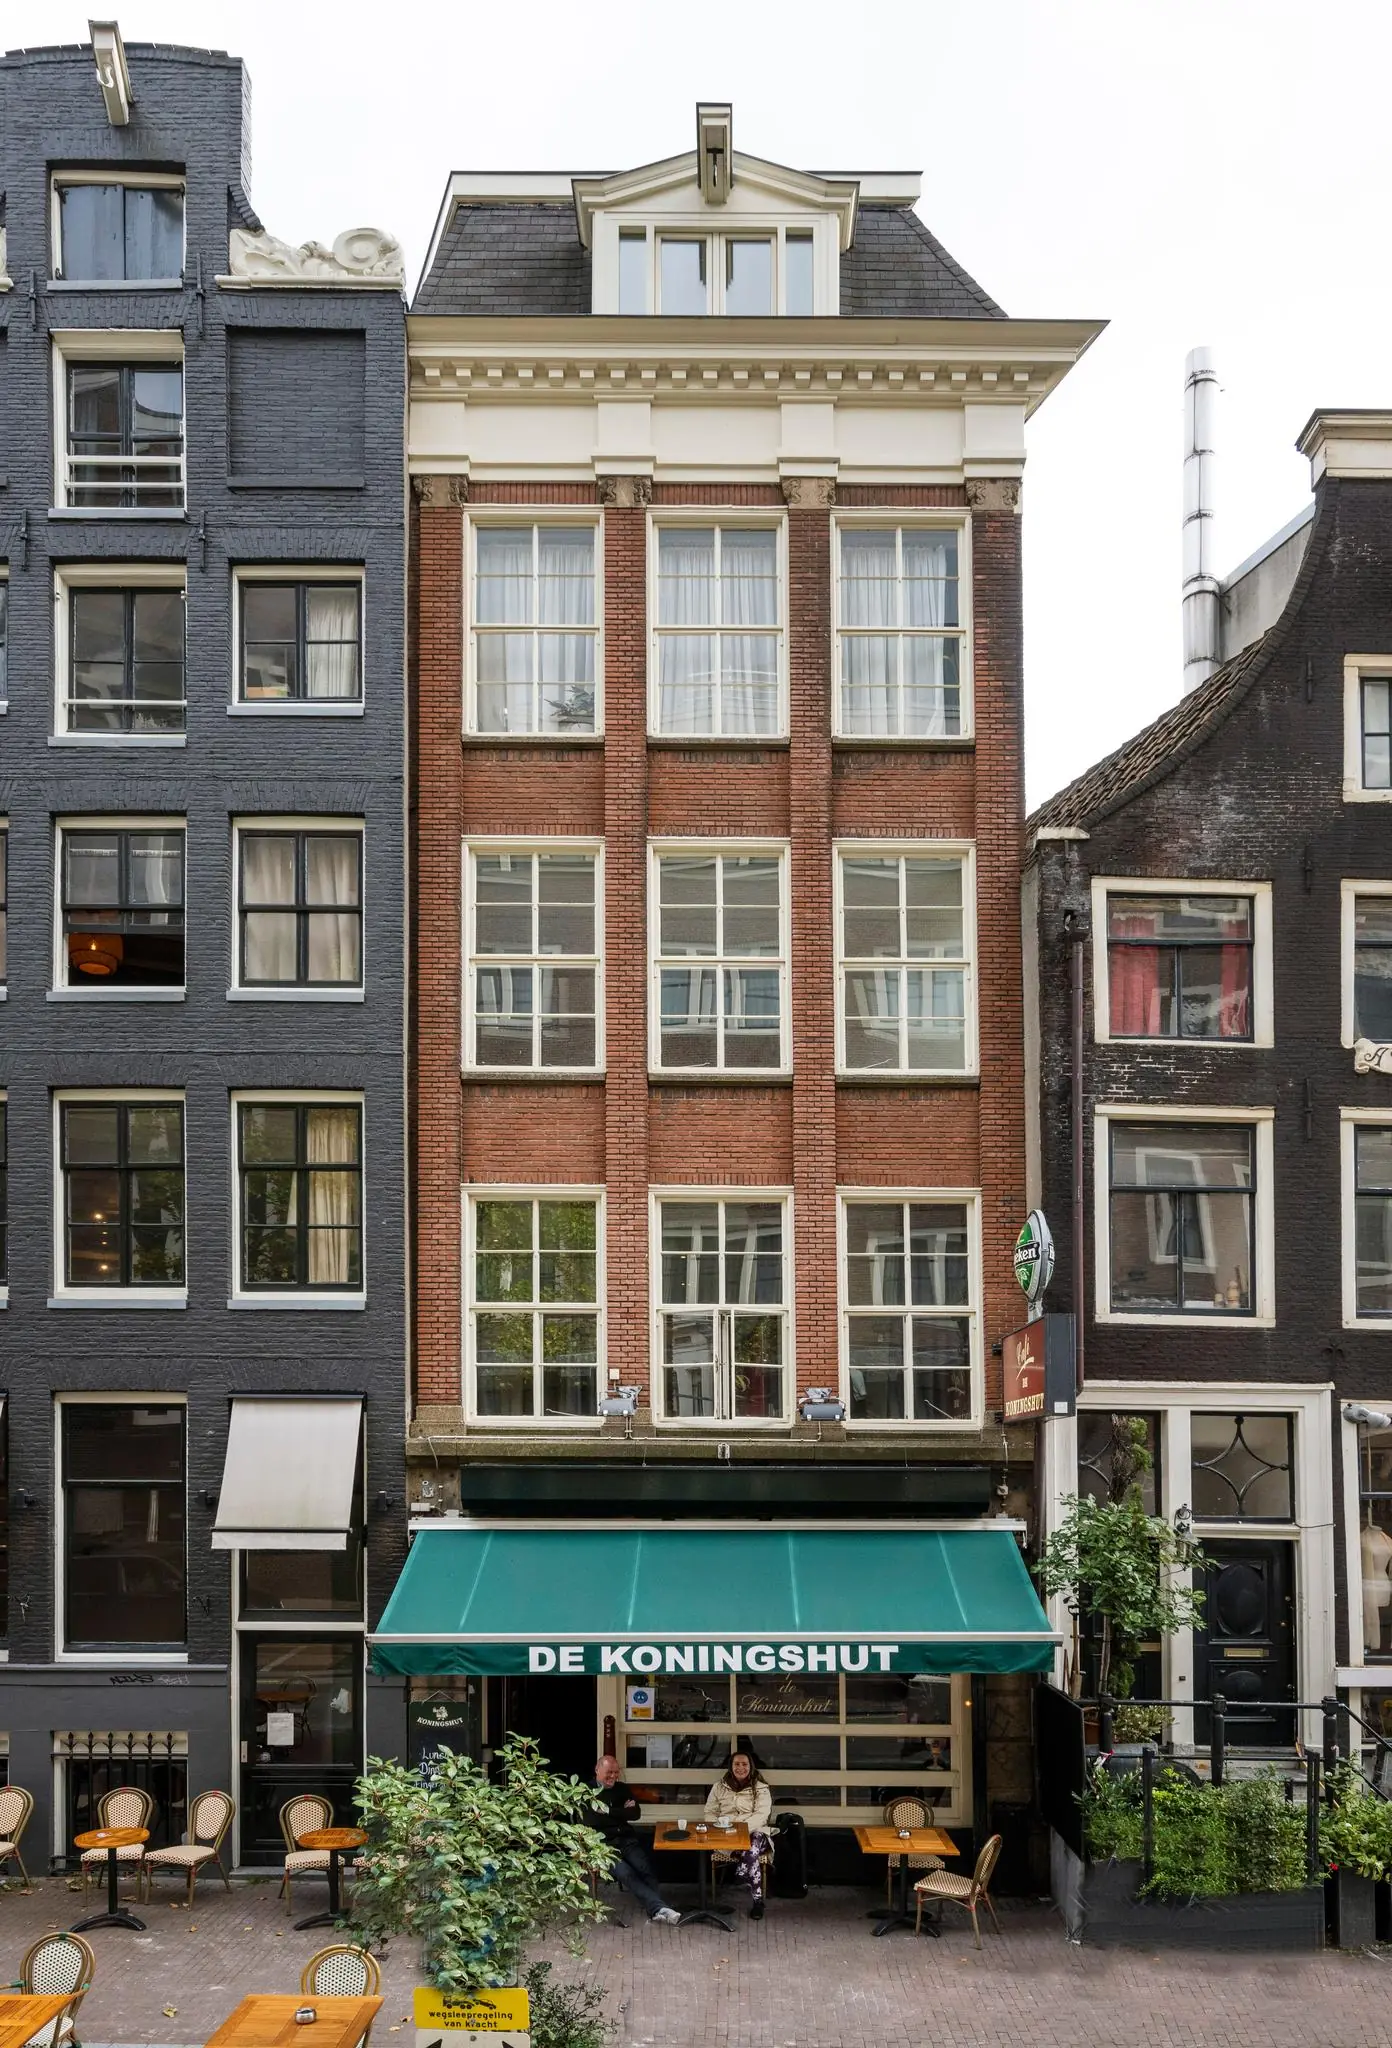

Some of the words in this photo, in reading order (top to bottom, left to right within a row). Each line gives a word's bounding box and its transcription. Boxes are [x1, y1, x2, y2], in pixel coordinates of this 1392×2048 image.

[1005, 1393, 1045, 1417] KONINGSHUT
[528, 1646, 585, 1672] DE
[601, 1645, 899, 1672] KONINGSHUT
[739, 1694, 833, 1717] Koningshut
[416, 1716, 464, 1727] KONINGSHUT
[428, 2010, 513, 2020] wegsleepregeling
[465, 2019, 498, 2028] kracht
